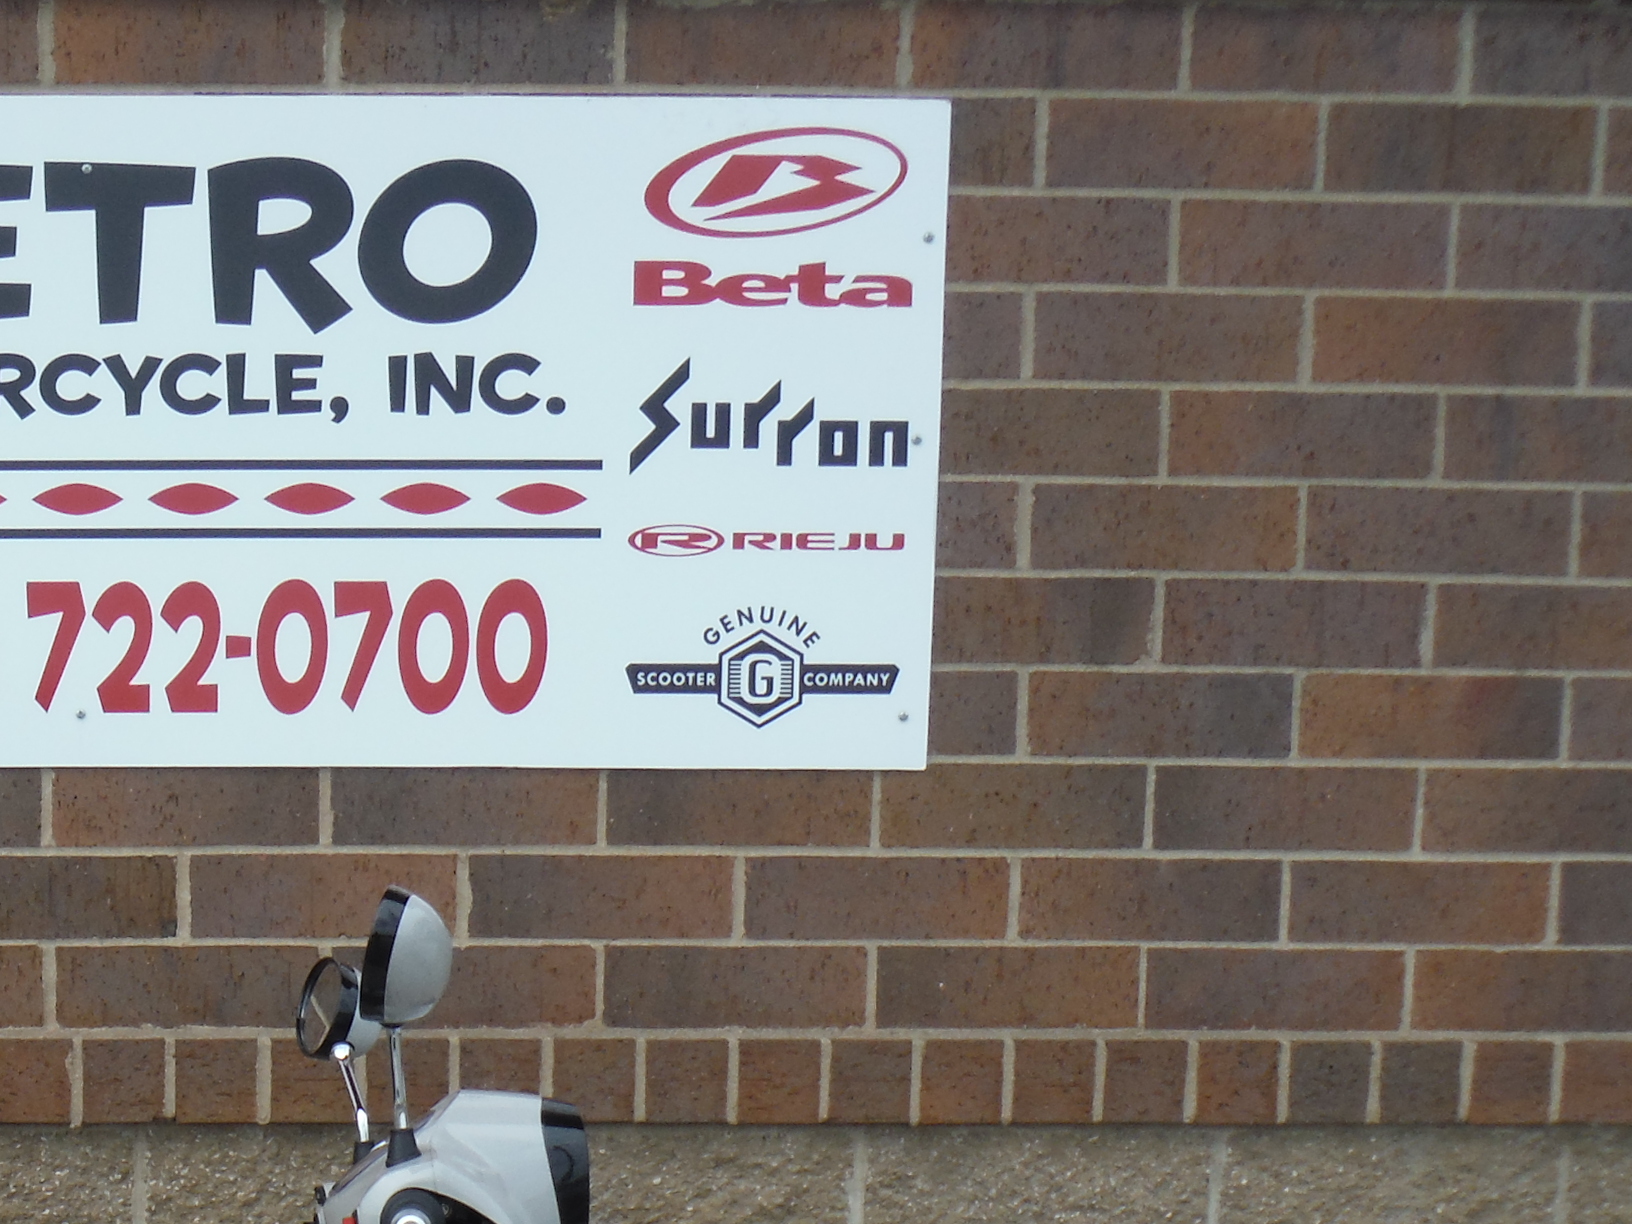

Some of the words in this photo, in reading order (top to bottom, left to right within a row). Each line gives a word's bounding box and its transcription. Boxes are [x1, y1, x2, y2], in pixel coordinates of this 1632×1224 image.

[633, 260, 913, 308] Beta
[388, 351, 567, 416] INC.
[629, 356, 910, 475] Surron
[731, 532, 906, 551] RIEJU
[26, 577, 549, 715] 722-0700
[703, 606, 821, 648] GENUINE
[636, 672, 716, 687] SCOOTER
[747, 659, 775, 698] G
[802, 671, 891, 687] COMPANY
